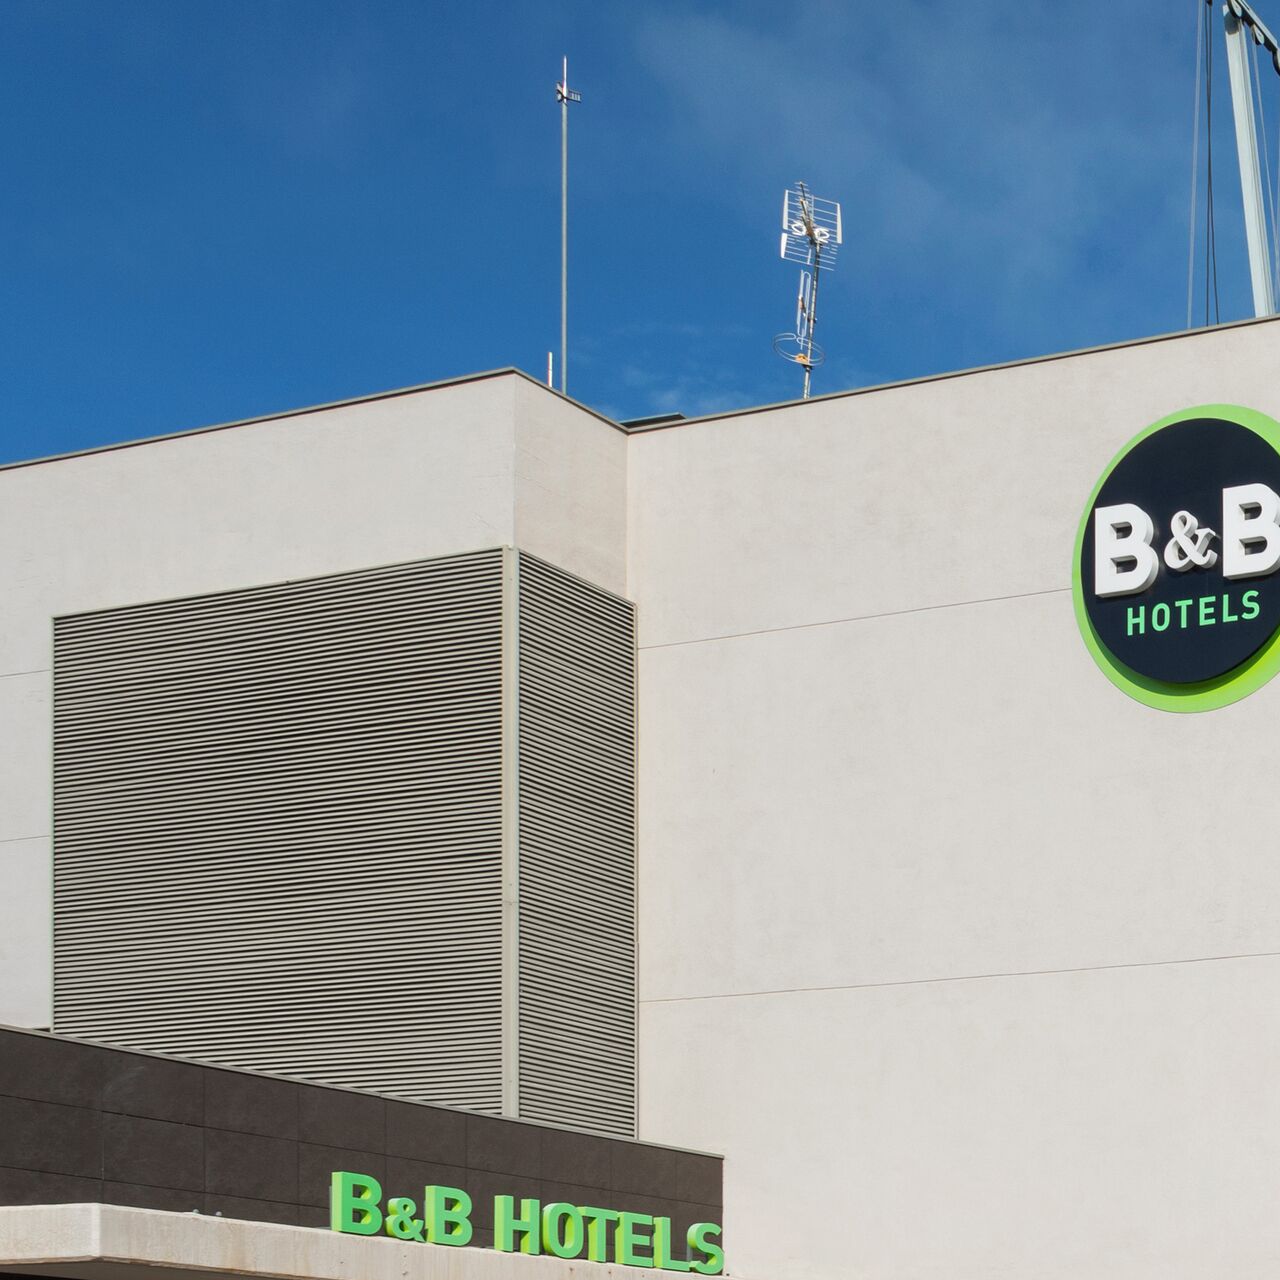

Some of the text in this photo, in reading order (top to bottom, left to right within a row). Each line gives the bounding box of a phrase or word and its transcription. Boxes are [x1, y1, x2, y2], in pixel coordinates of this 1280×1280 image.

[1126, 590, 1261, 636] HOTELS
[331, 1171, 725, 1275] B&B HOTELS
